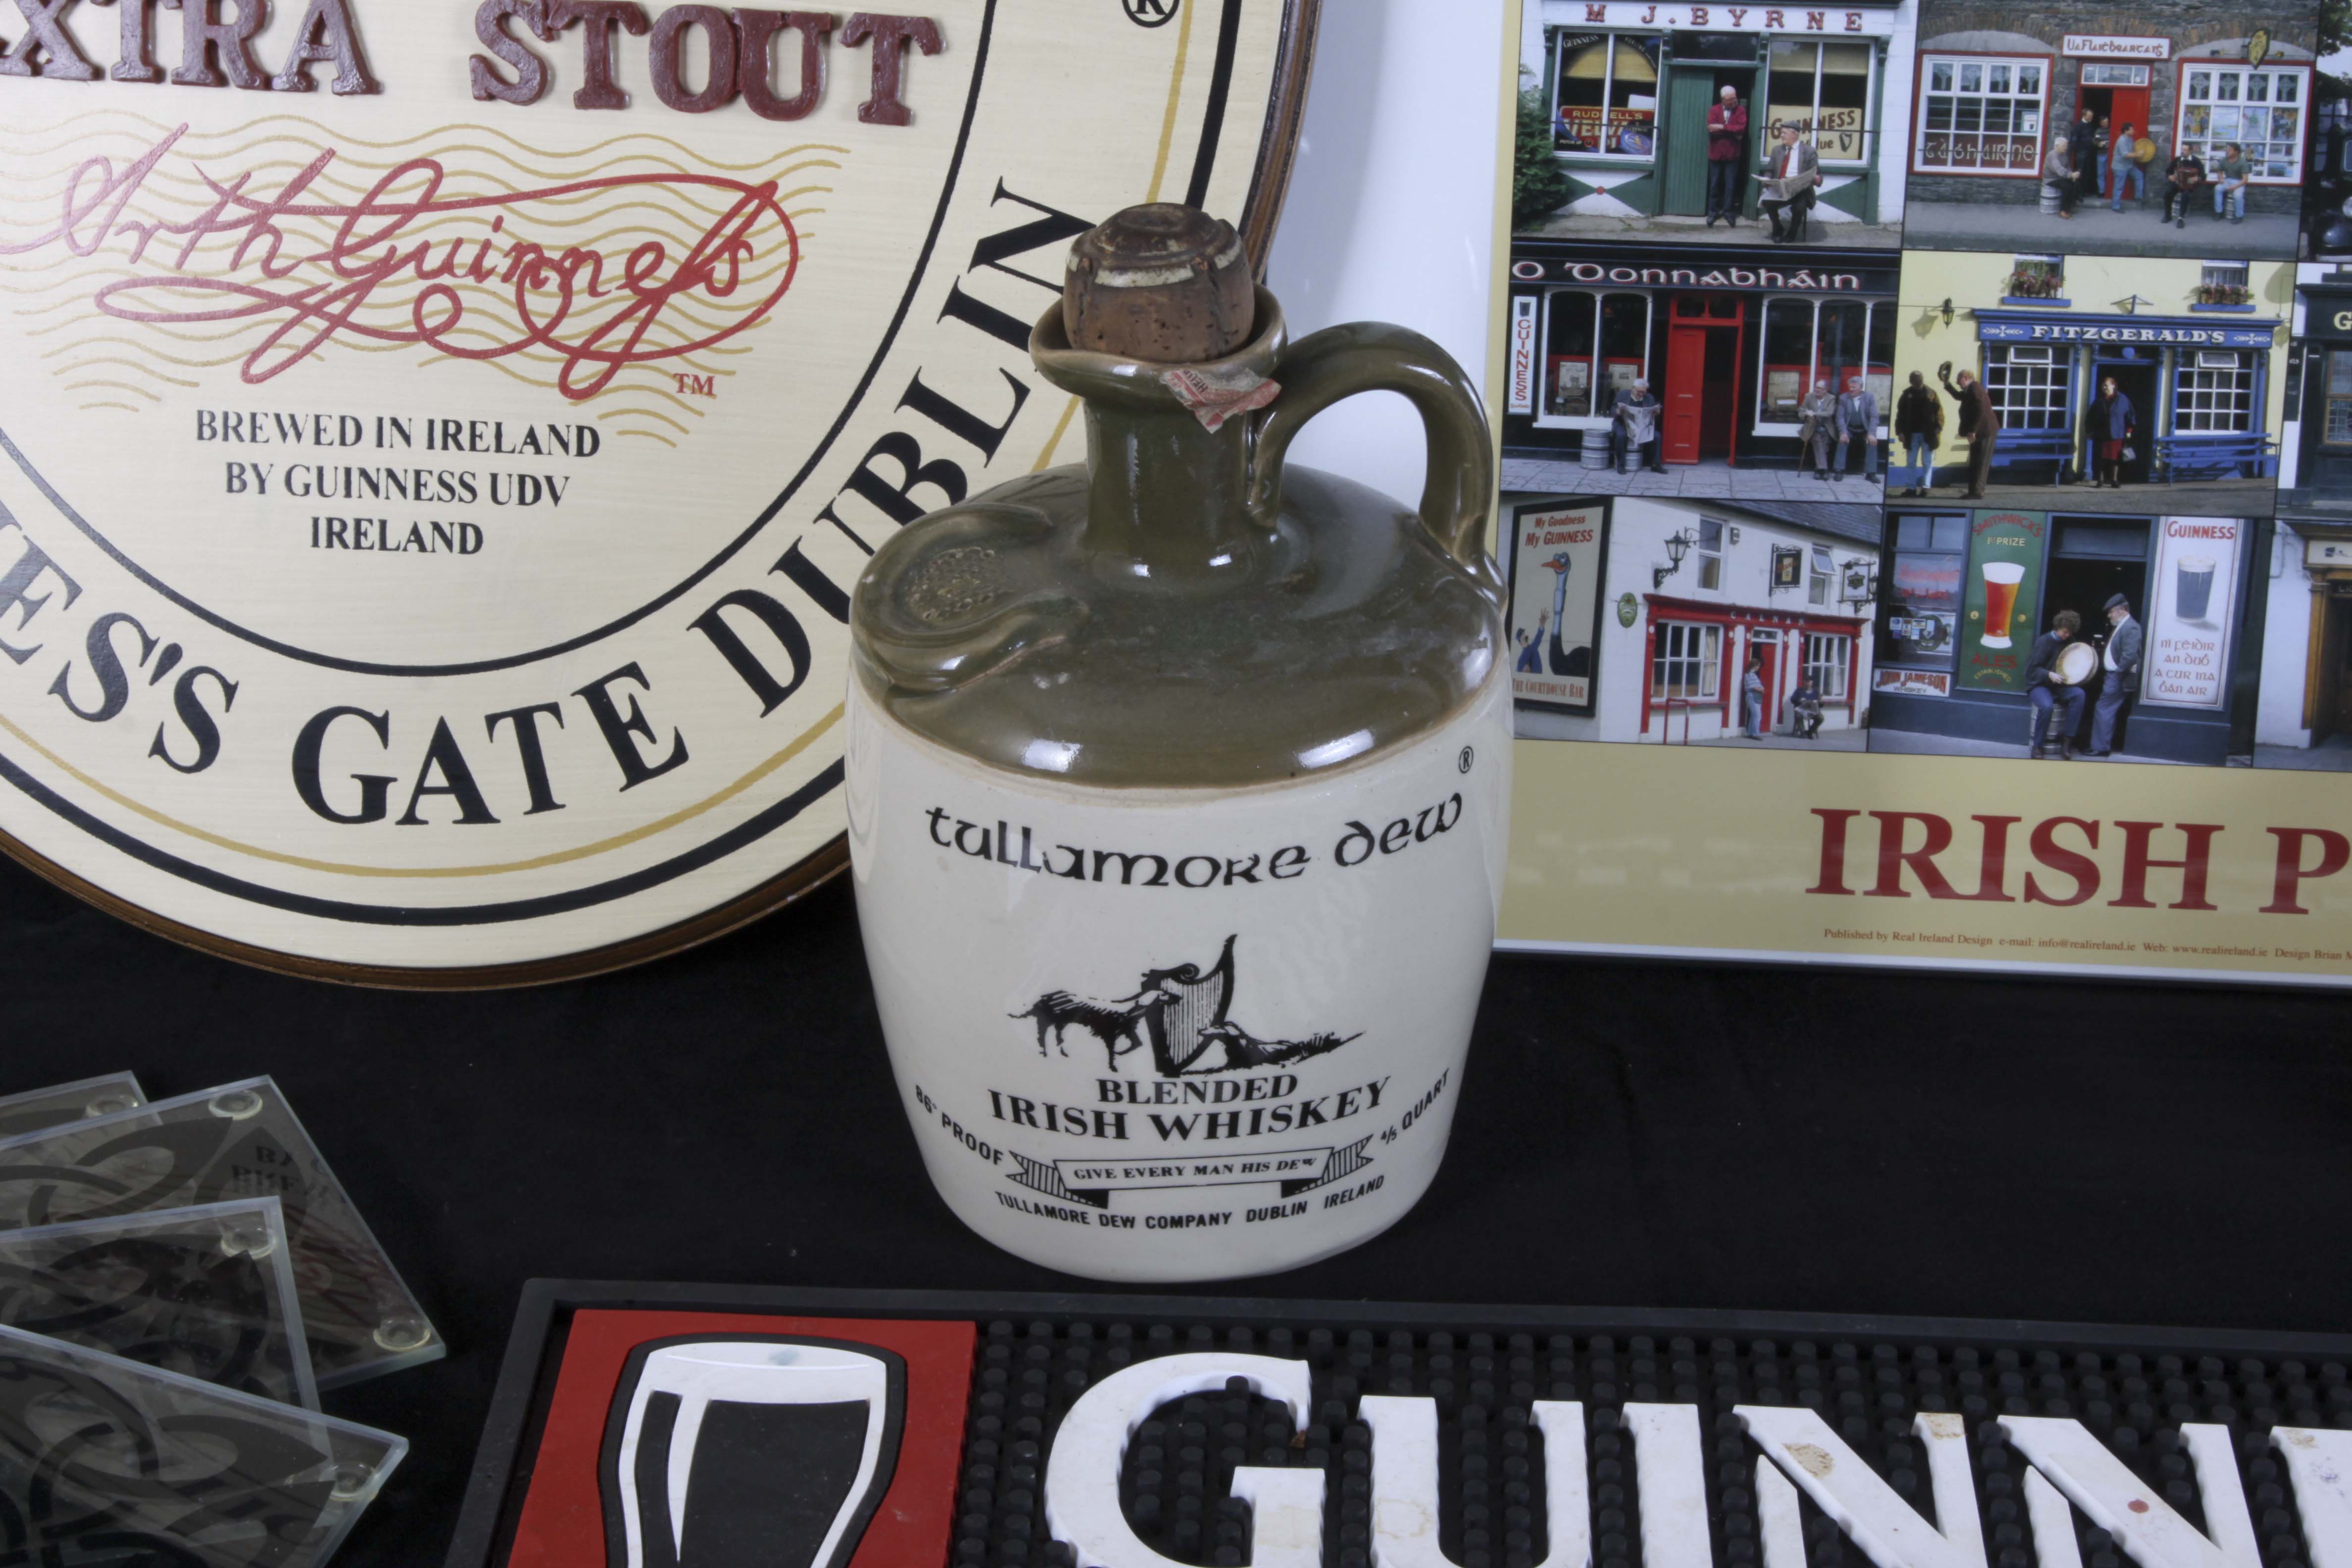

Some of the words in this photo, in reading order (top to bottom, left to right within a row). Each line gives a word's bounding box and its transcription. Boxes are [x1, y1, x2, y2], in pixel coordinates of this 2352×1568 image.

[1585, 4, 1605, 22] M
[1691, 7, 1863, 31] BYRNE
[1563, 35, 1599, 49] GUINNESS
[0, 0, 385, 96] XTRA
[469, 0, 942, 127] STOUT
[1572, 110, 1643, 120] RUDELL'S
[1512, 260, 1546, 281] O
[2032, 325, 2226, 345] FITZGERALD'S
[1515, 319, 1531, 401] GUINNESS
[196, 409, 362, 448] BREWED
[375, 416, 414, 449] IN
[426, 418, 601, 458] IRELAND
[225, 461, 275, 495] BY
[284, 463, 479, 504] GUINNESS
[489, 473, 571, 508] UDV
[0, 499, 239, 774] ES'S
[292, 661, 689, 825] GATE
[686, 176, 1097, 718] DUBLIN
[310, 516, 485, 555] IRELAND
[1535, 516, 1545, 529] My
[1548, 515, 1585, 528] Goodness
[2167, 521, 2235, 540] GUINNESS
[1525, 533, 1540, 548] My
[1543, 530, 1594, 545] GUINNESS
[1996, 537, 2026, 546] PRIZE
[1971, 653, 2018, 669] ALES
[1525, 679, 1567, 697] COURTHOUSE
[1569, 683, 1584, 699] BAR
[1876, 670, 1901, 688] JOHN
[1901, 672, 1947, 694] JAMESON
[1334, 792, 1464, 868] dew
[1805, 808, 2225, 912] IRISH
[2259, 826, 2352, 915] P
[1824, 929, 1873, 940] Published
[1877, 931, 1888, 942] by
[1892, 931, 1915, 941] Real
[1919, 932, 1954, 943] Ireland
[1958, 934, 1993, 946] Design
[1999, 936, 2035, 947] e-mail:
[2038, 938, 2136, 951] info@realireland.ie
[2143, 942, 2168, 953] Web:
[2172, 944, 2268, 958] www.realireland.ie
[2275, 947, 2310, 961] Design
[2314, 950, 2342, 961] Brian
[1095, 1074, 1298, 1105] BLENDED
[1401, 1067, 1450, 1131] QUART
[987, 1089, 1130, 1140] IRISH
[1146, 1075, 1391, 1142] WHISKEY
[941, 1111, 1004, 1167] PROOF
[1074, 1168, 1117, 1179] GIVE
[1124, 1166, 1186, 1178] EVERY
[1193, 1164, 1234, 1176] MAN
[1240, 1161, 1271, 1174] HIS
[1275, 1156, 1318, 1172] DEW
[994, 1191, 1090, 1225] TULLAMORE
[1098, 1213, 1136, 1229] DEW
[1145, 1211, 1233, 1229] COMPANY
[1246, 1200, 1308, 1223] DUBLIN
[1323, 1175, 1384, 1210] IRELAND
